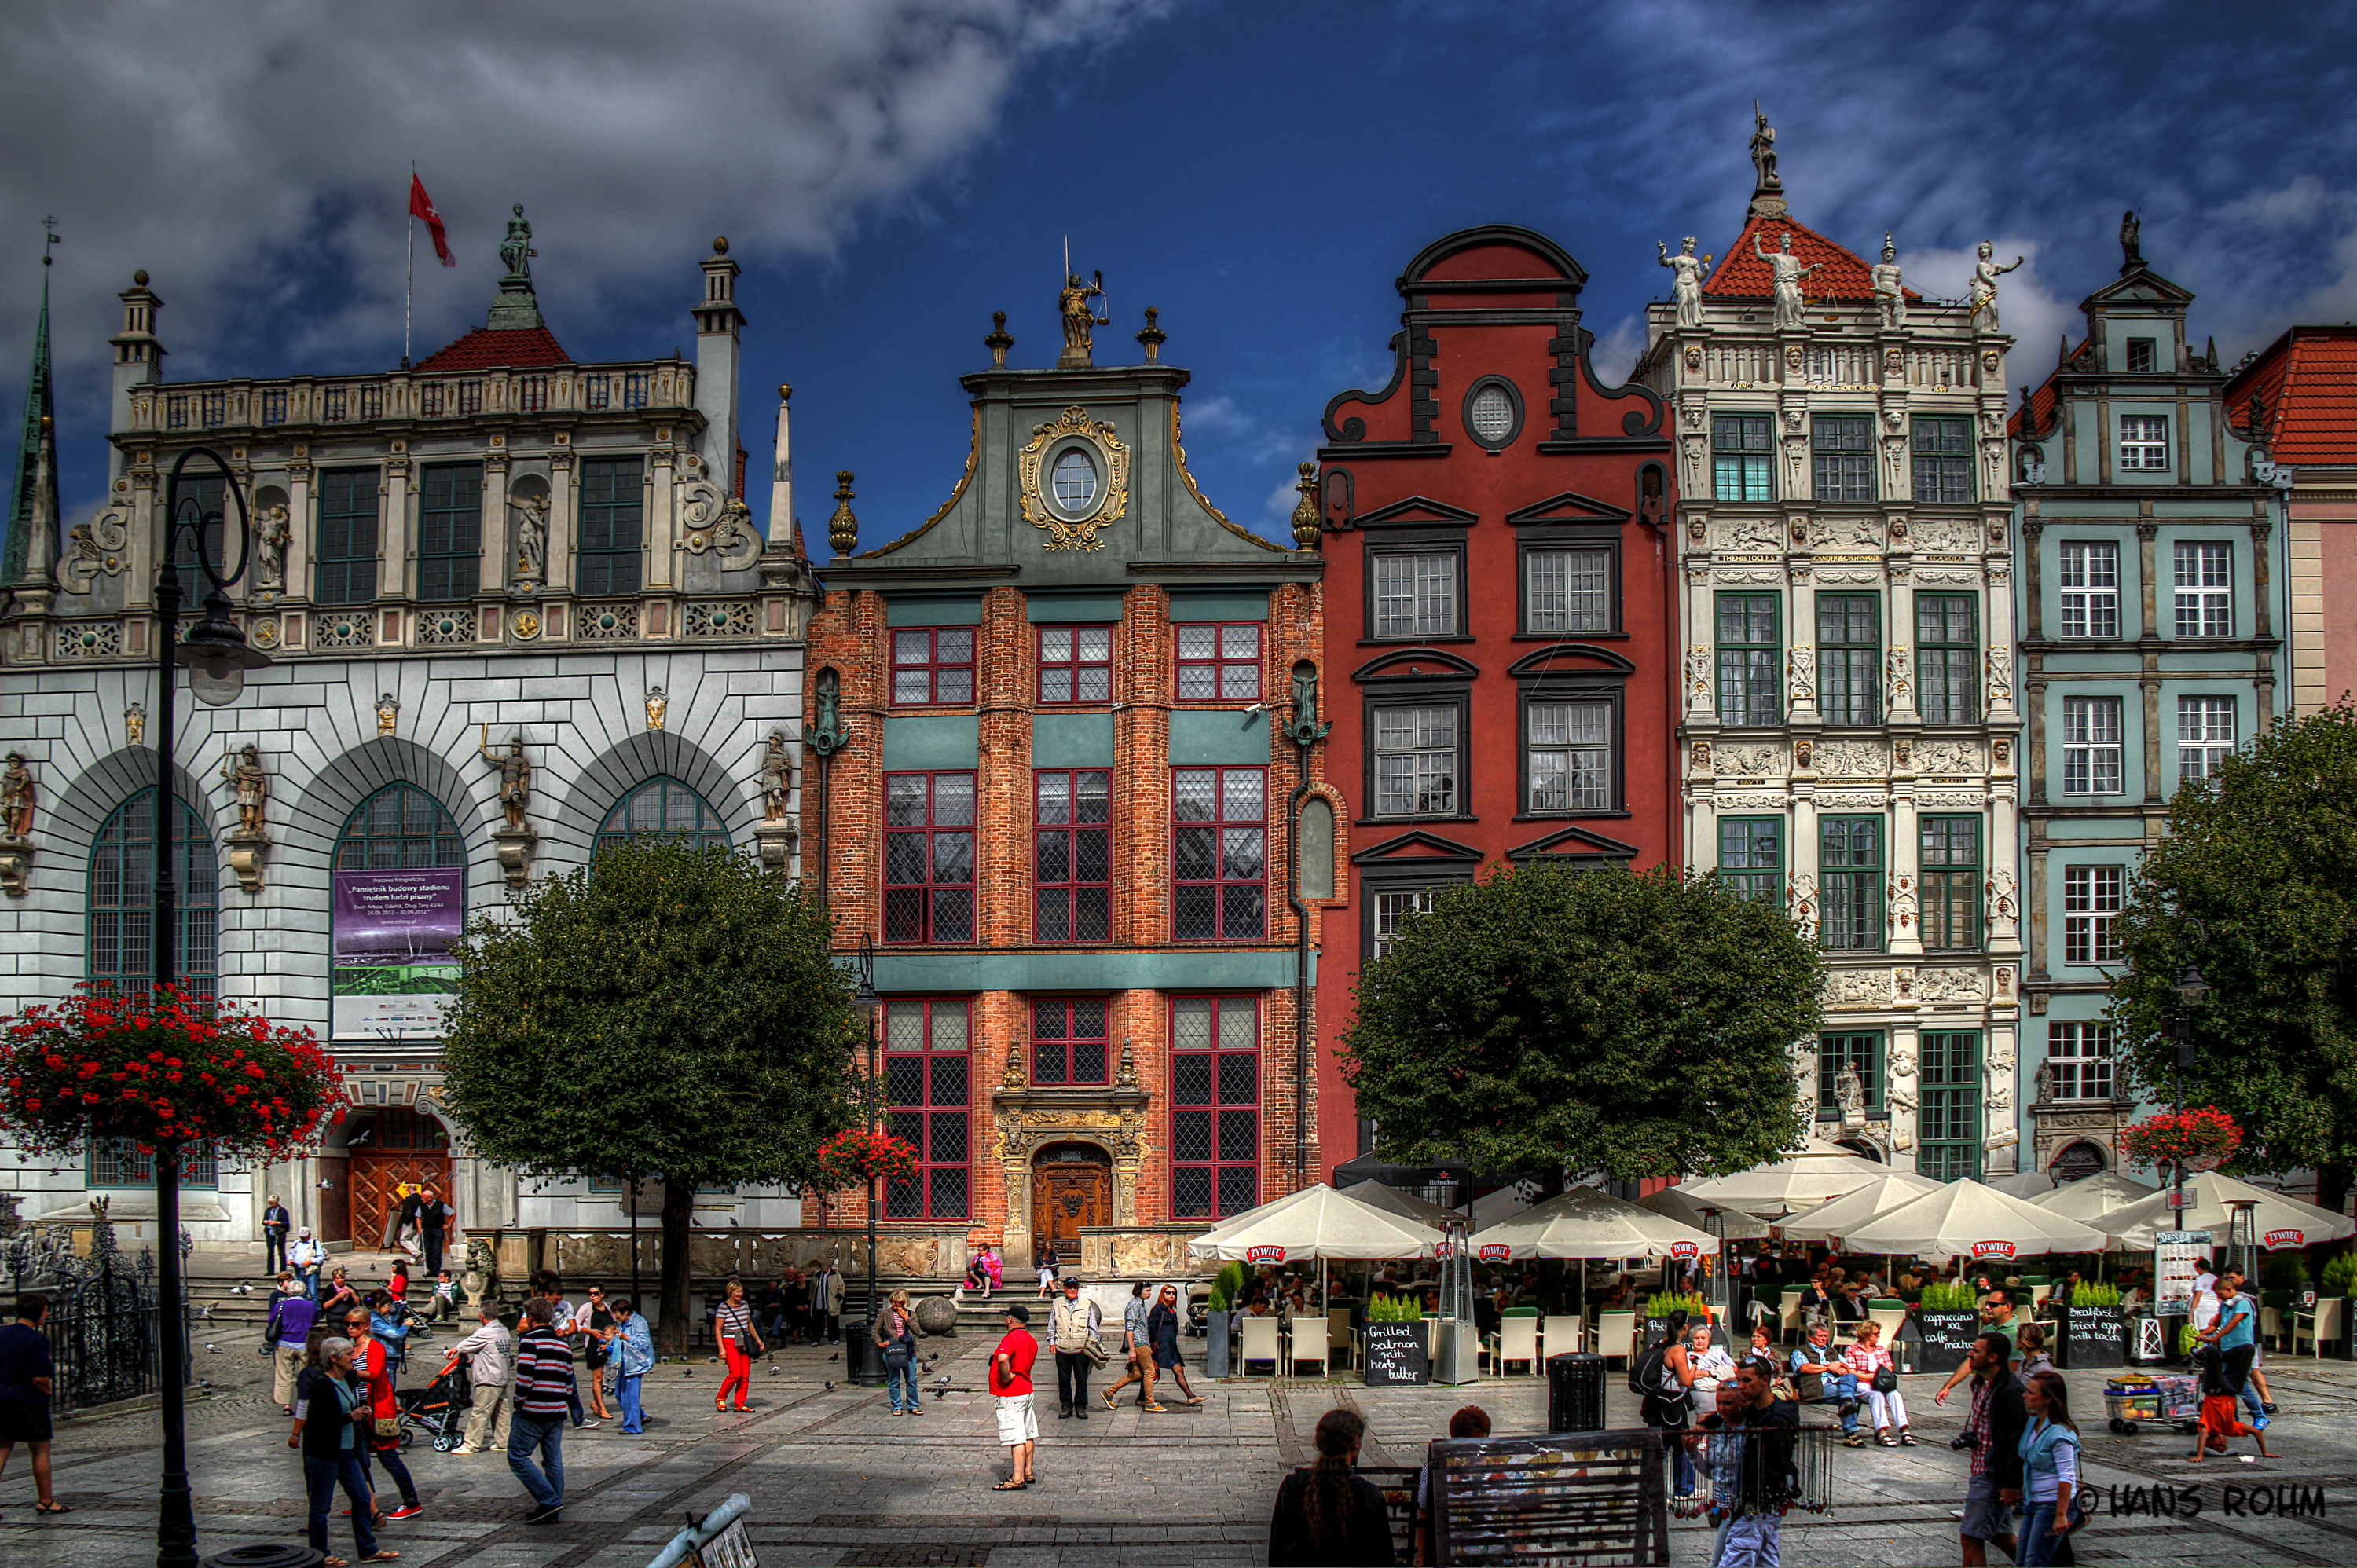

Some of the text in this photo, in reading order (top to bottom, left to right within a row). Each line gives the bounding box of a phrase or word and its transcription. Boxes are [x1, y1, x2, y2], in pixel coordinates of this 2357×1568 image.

[348, 885, 387, 894] „Pamiętnik
[2159, 1233, 2187, 1242] MENU
[1923, 1313, 1974, 1326] cappuccino
[2069, 1306, 2118, 1320] Breakfast:
[1369, 1324, 1412, 1338] Grilled
[2068, 1320, 2122, 1335] Fried eggs
[1925, 1330, 1948, 1343] caffe
[2094, 1331, 2121, 1341] bacon
[1370, 1339, 1419, 1350] salmon
[1370, 1358, 1395, 1369] herb
[1388, 1365, 1419, 1382] butter
